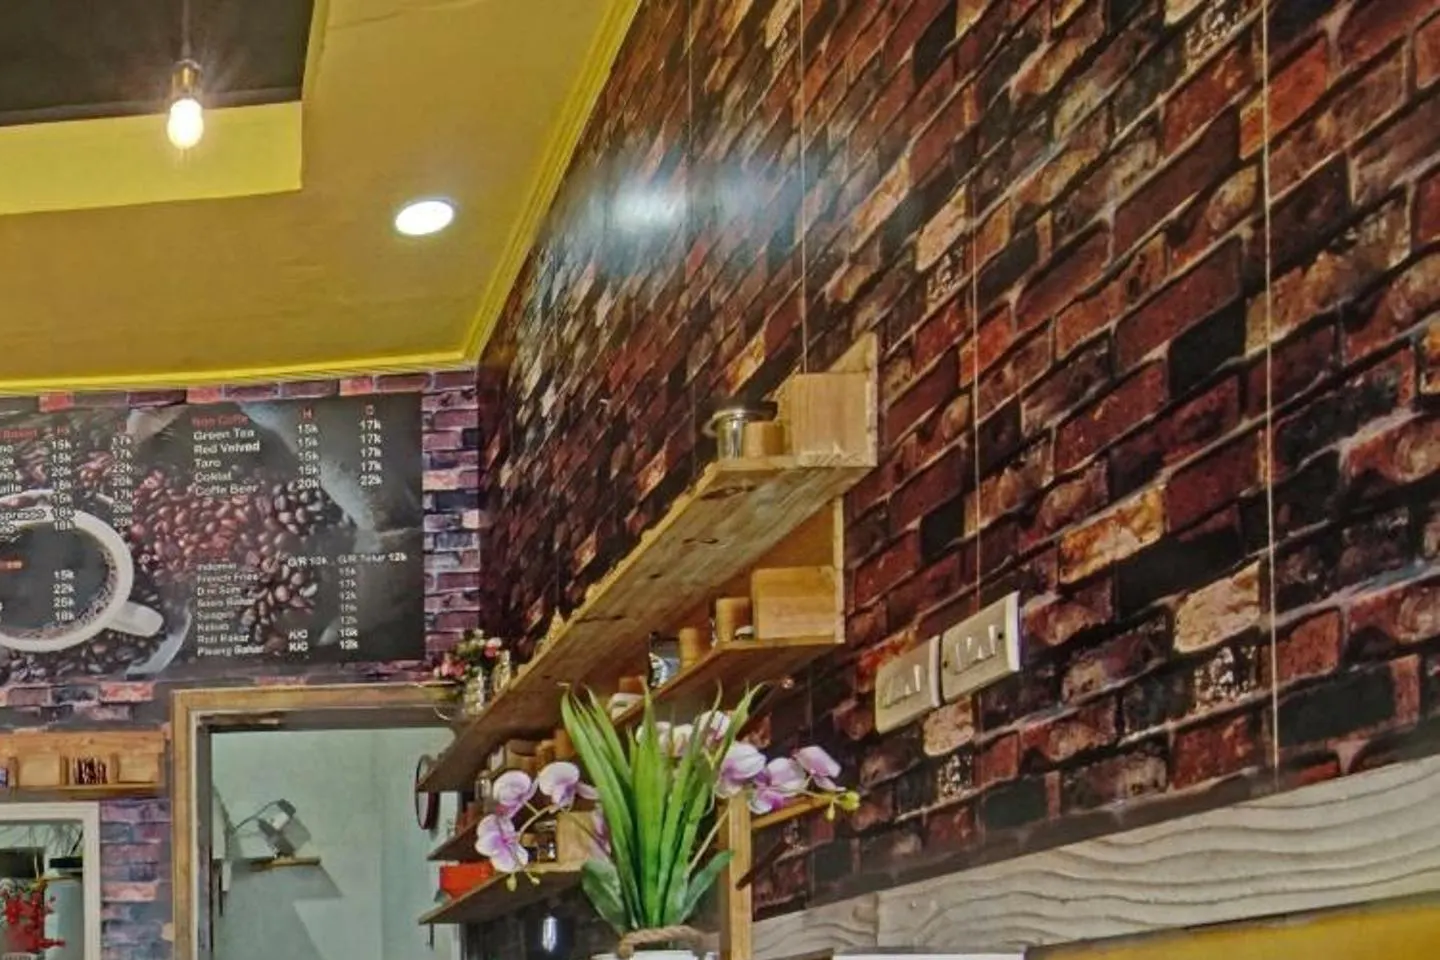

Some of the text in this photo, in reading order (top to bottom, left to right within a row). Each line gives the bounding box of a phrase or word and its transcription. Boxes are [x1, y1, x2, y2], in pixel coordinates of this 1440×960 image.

[193, 431, 230, 441] Green
[233, 428, 255, 438] Tea
[193, 444, 218, 454] Red
[194, 458, 221, 468] Taro
